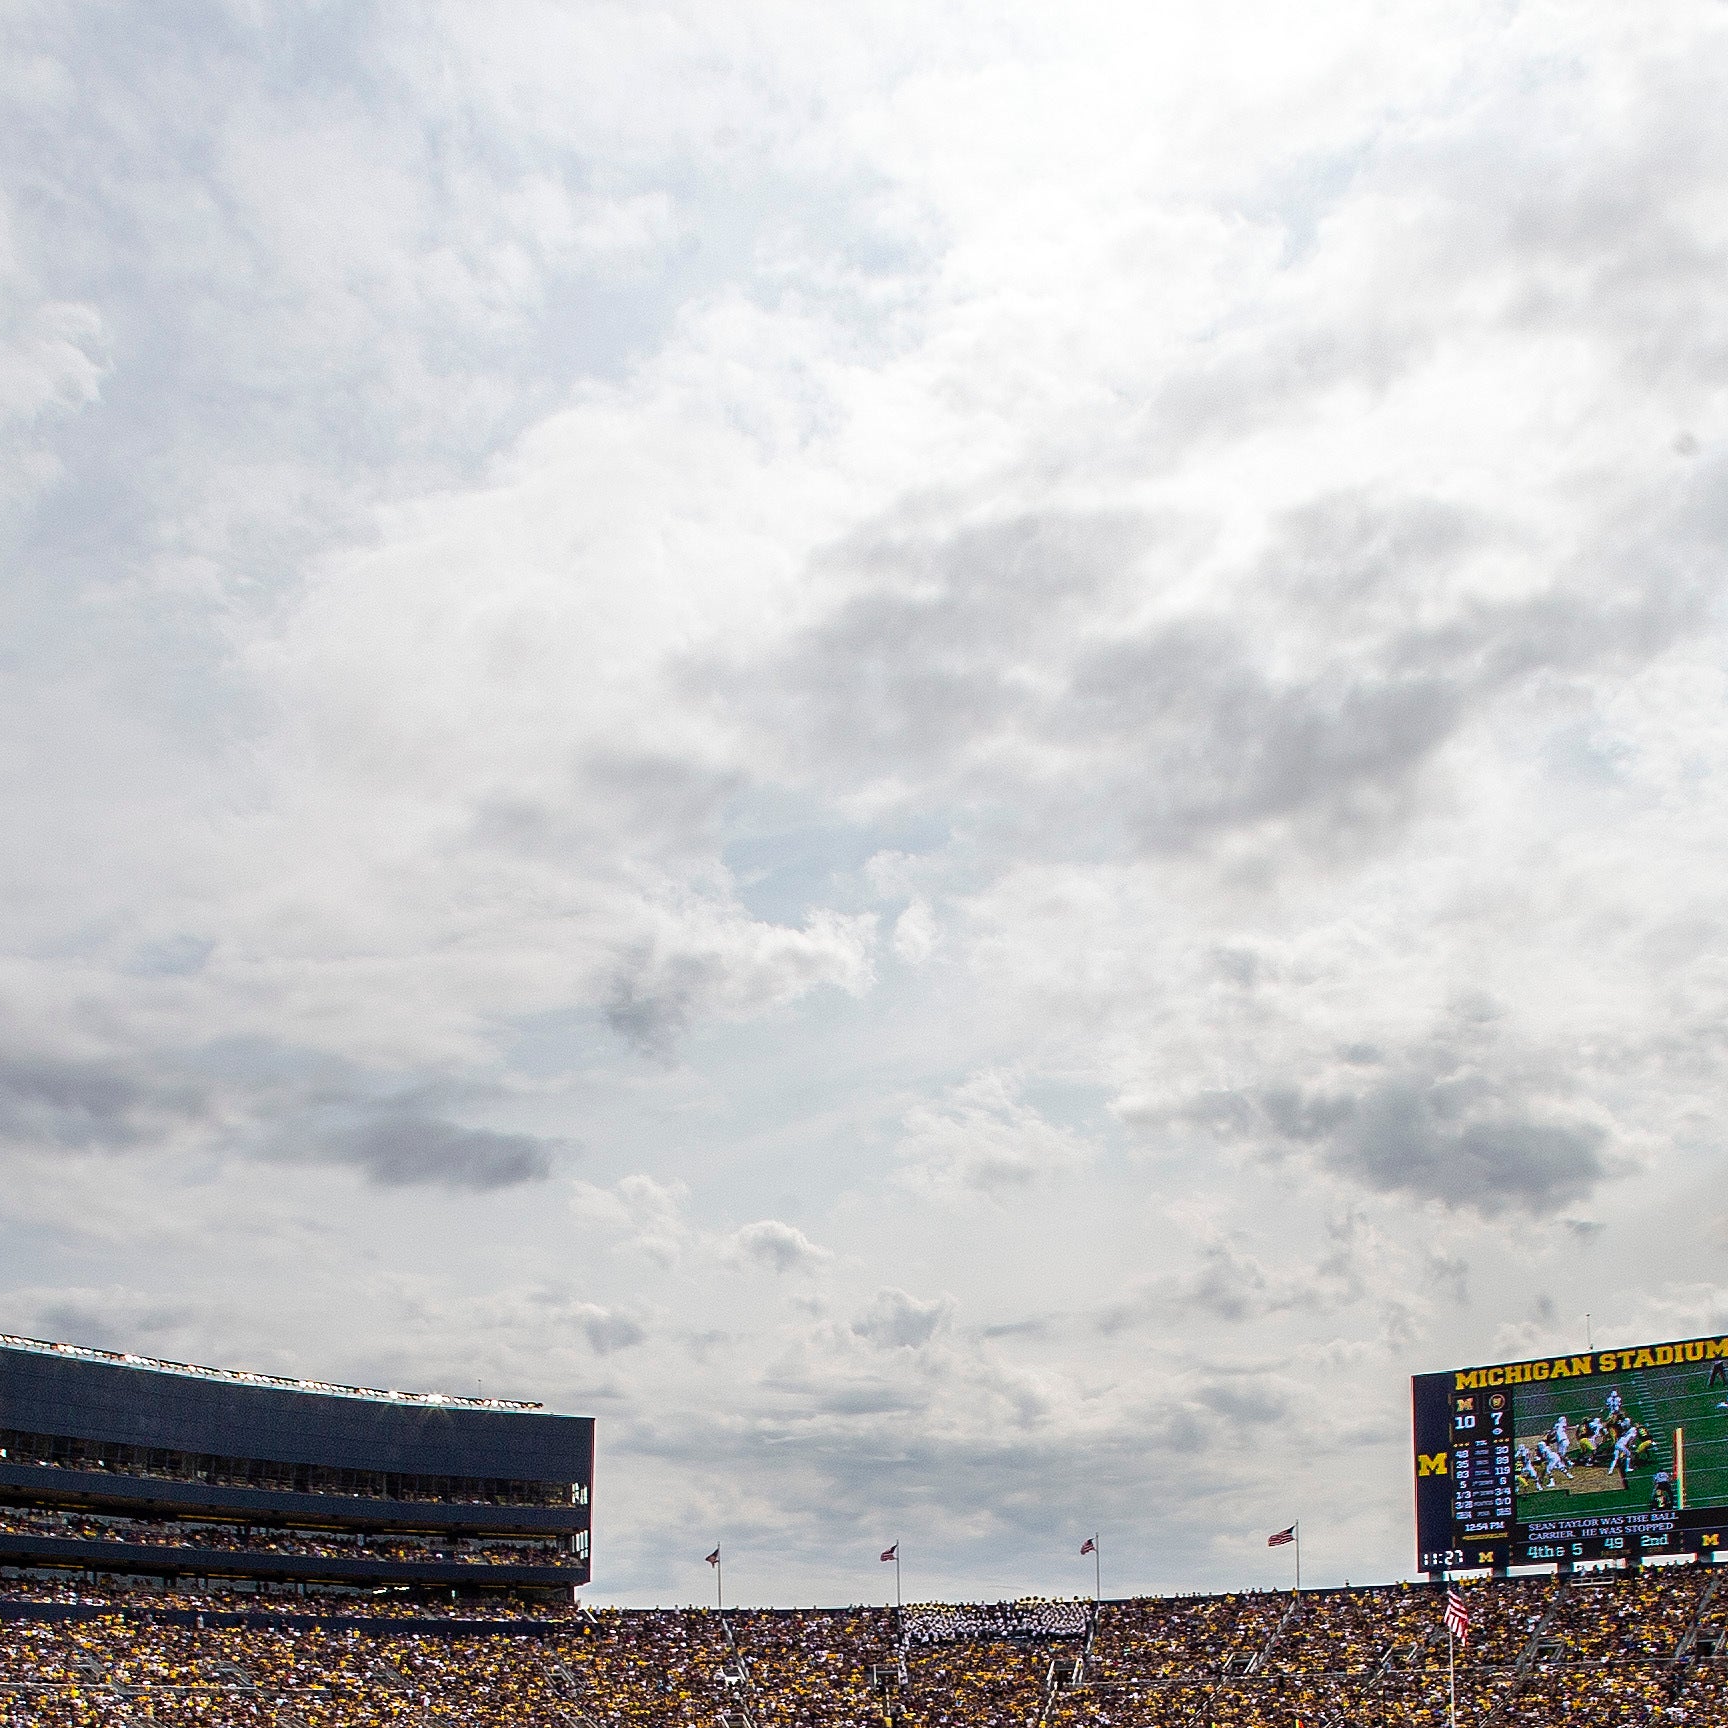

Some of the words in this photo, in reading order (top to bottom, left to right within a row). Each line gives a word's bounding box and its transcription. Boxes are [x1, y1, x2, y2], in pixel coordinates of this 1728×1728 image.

[1455, 1356, 1591, 1391] MICHIGAN
[1455, 1397, 1474, 1412] M
[1454, 1415, 1476, 1430] 10
[1491, 1411, 1503, 1426] 7
[1417, 1451, 1448, 1477] M
[1528, 1522, 1556, 1532] SEAN
[1558, 1519, 1600, 1529] TAYLOR
[1600, 1516, 1625, 1526] WAS
[1626, 1514, 1649, 1523] THE
[1651, 1512, 1680, 1521] BALL
[1582, 1528, 1598, 1537] HE
[1598, 1526, 1623, 1535] WAS
[1624, 1523, 1674, 1534] STOPPED
[1604, 1537, 1624, 1549] 49
[1640, 1533, 1669, 1547] 2nd
[1702, 1533, 1719, 1546] M
[1572, 1543, 1583, 1556] 5
[1478, 1551, 1494, 1563] M
